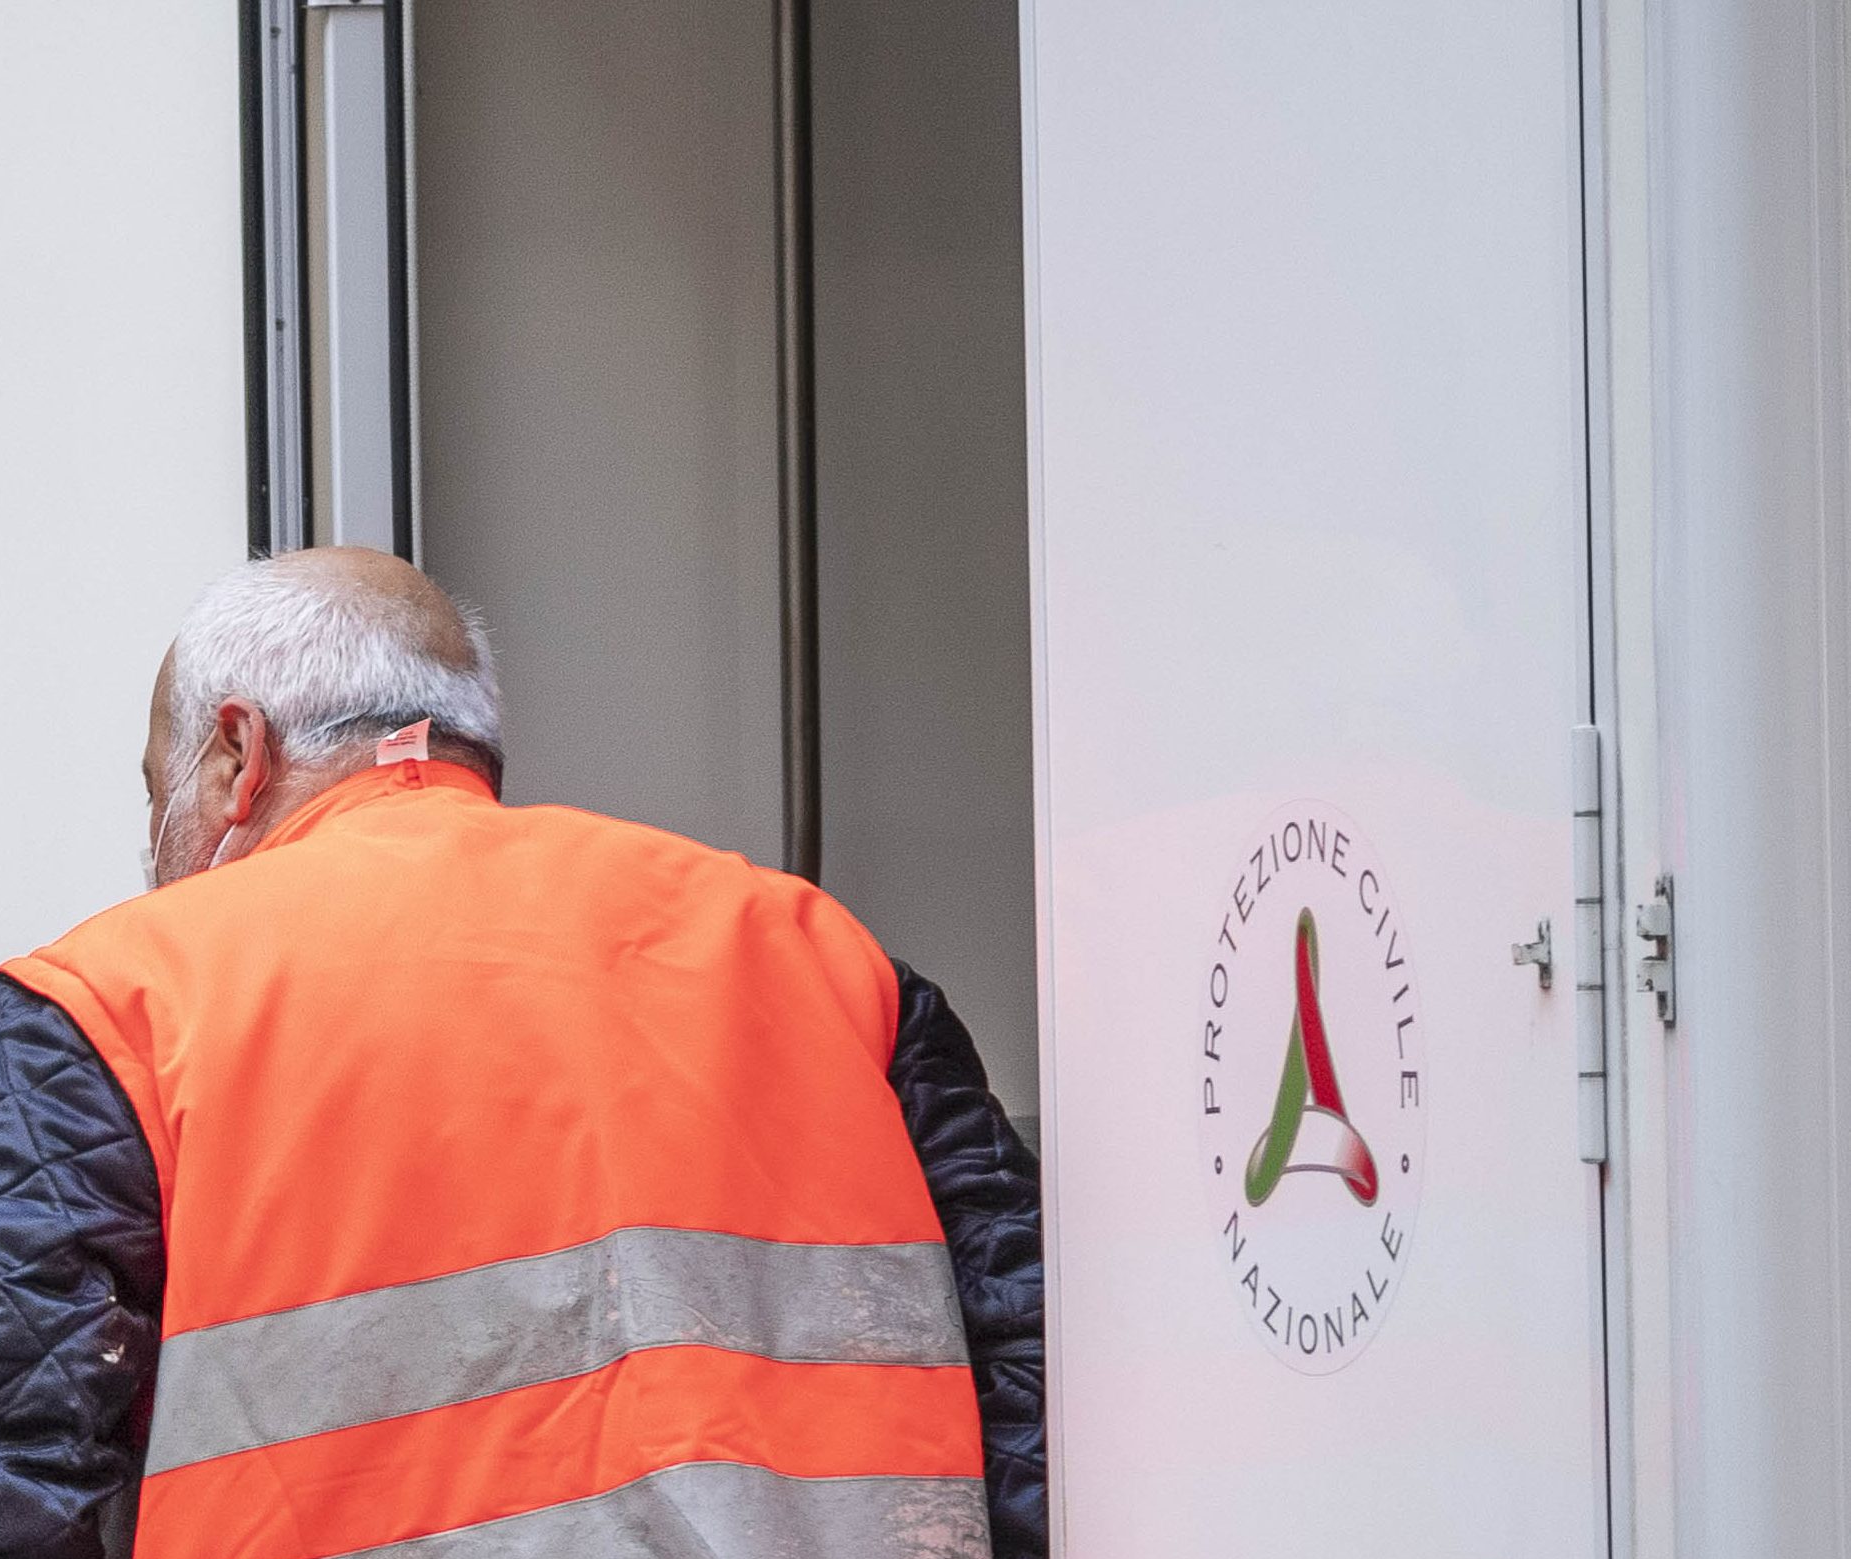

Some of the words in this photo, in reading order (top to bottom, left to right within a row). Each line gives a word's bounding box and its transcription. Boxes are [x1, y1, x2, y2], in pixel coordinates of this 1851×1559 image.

[1204, 818, 1351, 1116] PROTEZIONE
[1358, 870, 1419, 1110] CIVILE
[1224, 1212, 1404, 1356] NAZIONALE
